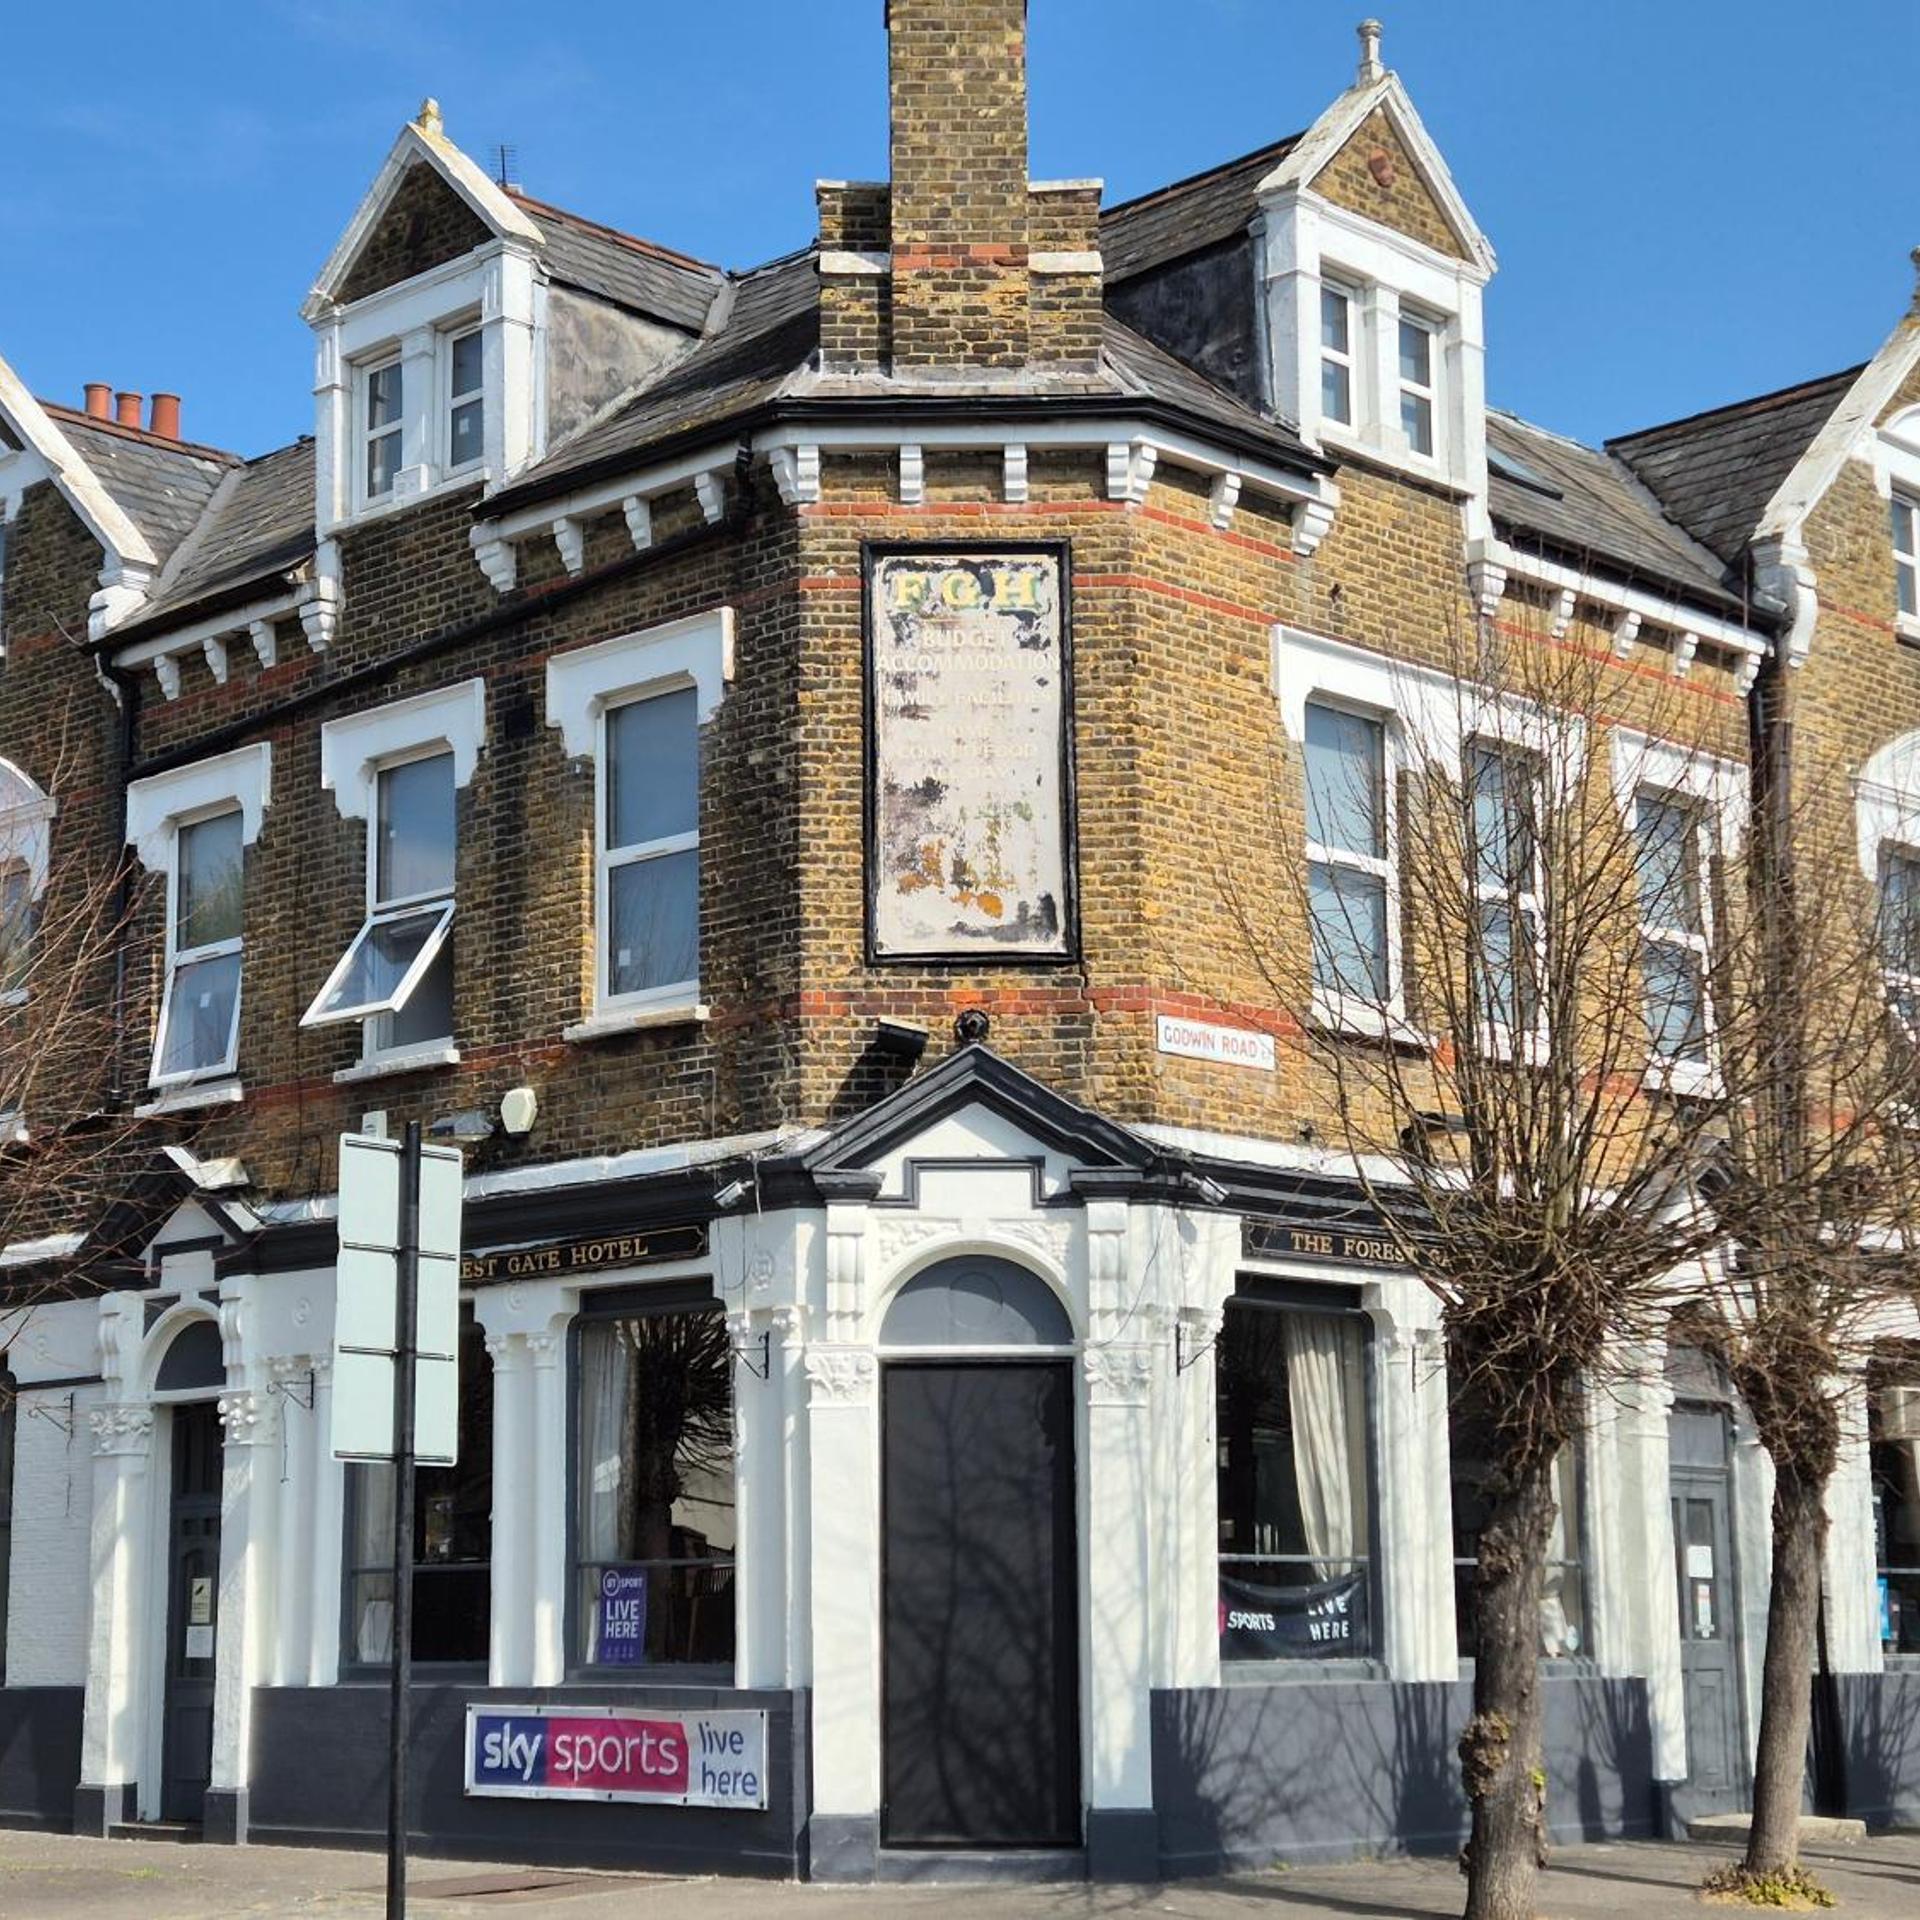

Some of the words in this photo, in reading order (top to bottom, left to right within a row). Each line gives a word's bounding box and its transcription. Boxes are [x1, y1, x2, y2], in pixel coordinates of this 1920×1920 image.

[922, 629, 1007, 648] BUDGET
[876, 653, 1060, 672] ACCOMMODATION
[1163, 1024, 1216, 1052] GODWIN
[1221, 1034, 1258, 1059] ROAD
[1290, 1231, 1333, 1254] THE
[460, 1258, 498, 1279] EST
[507, 1250, 560, 1275] GATE
[571, 1237, 649, 1267] HOTEL
[606, 1599, 639, 1620] LIVE
[606, 1621, 638, 1639] HERE
[1227, 1610, 1276, 1631] SPORTS
[1310, 1620, 1349, 1641] HERE
[483, 1721, 543, 1782] sky
[553, 1728, 680, 1782] sports
[698, 1721, 745, 1755] live
[701, 1761, 758, 1796] here
